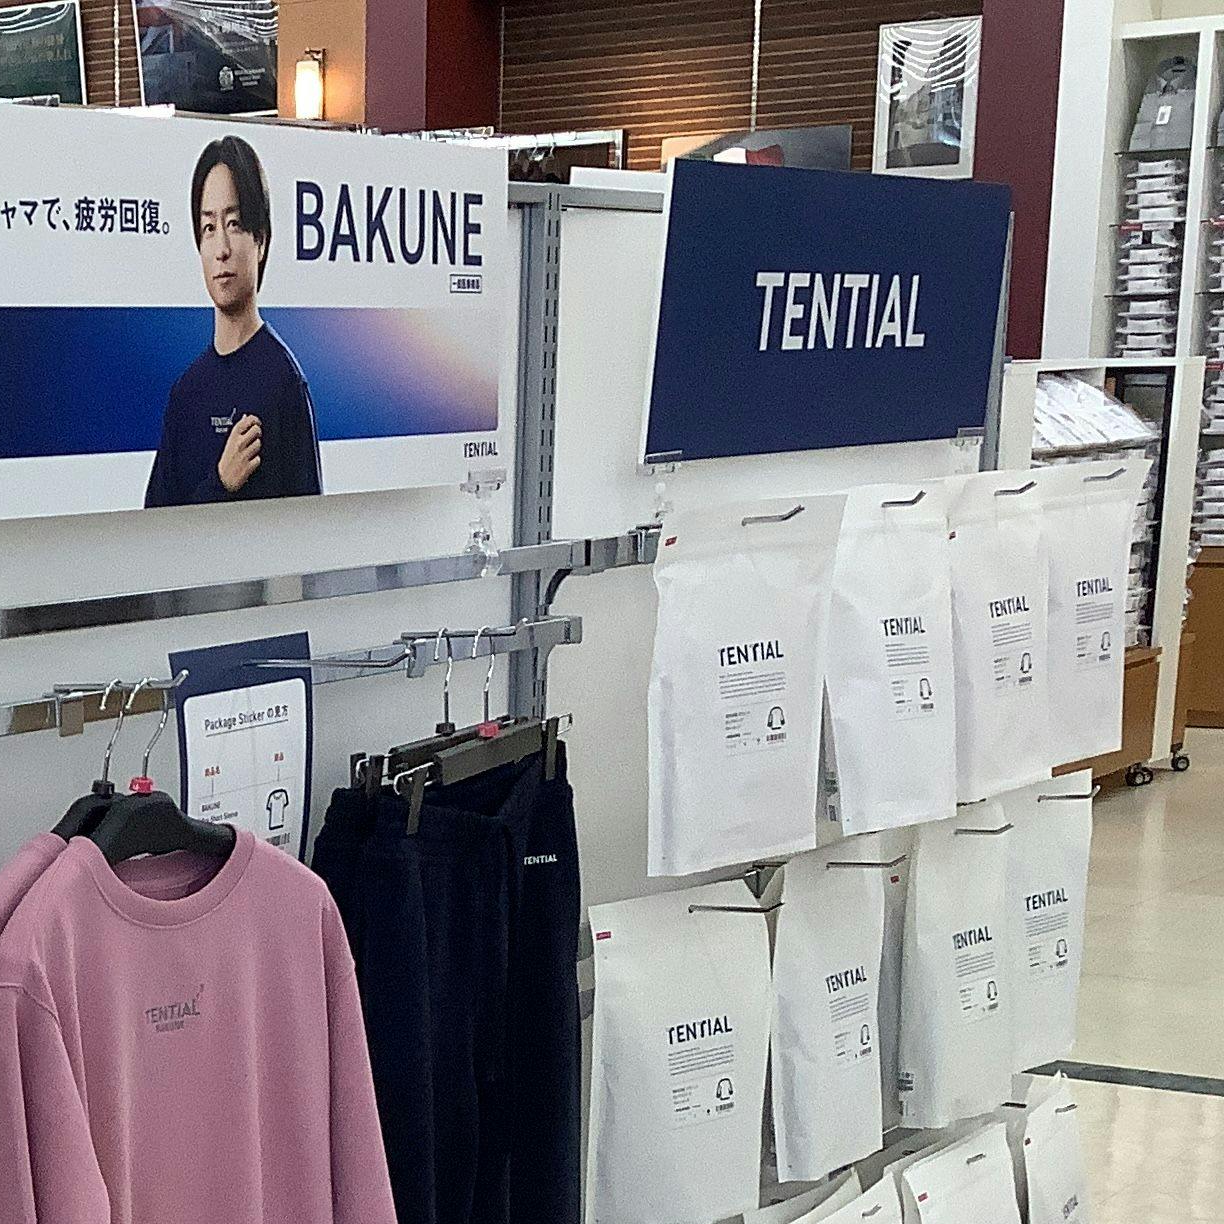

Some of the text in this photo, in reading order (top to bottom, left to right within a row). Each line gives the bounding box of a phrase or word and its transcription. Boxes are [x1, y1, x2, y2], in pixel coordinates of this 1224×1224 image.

[295, 180, 483, 267] BAKUNE
[756, 271, 925, 351] TENTIAL
[463, 441, 498, 458] TENTIAL
[1076, 576, 1113, 597] TENTIAL
[989, 595, 1030, 619] TENTIAL
[879, 616, 926, 637] TENTIAL
[717, 639, 784, 667] TENTIAL
[204, 715, 236, 731] Package
[238, 710, 265, 725] Sticker
[523, 854, 558, 866] TENTIAL
[1024, 887, 1069, 912] TENTIAL
[952, 925, 993, 951] TENTIAL
[825, 965, 867, 994] TENTIAL
[144, 999, 201, 1025] TENTIAL
[666, 1015, 733, 1045] TENTIAL
